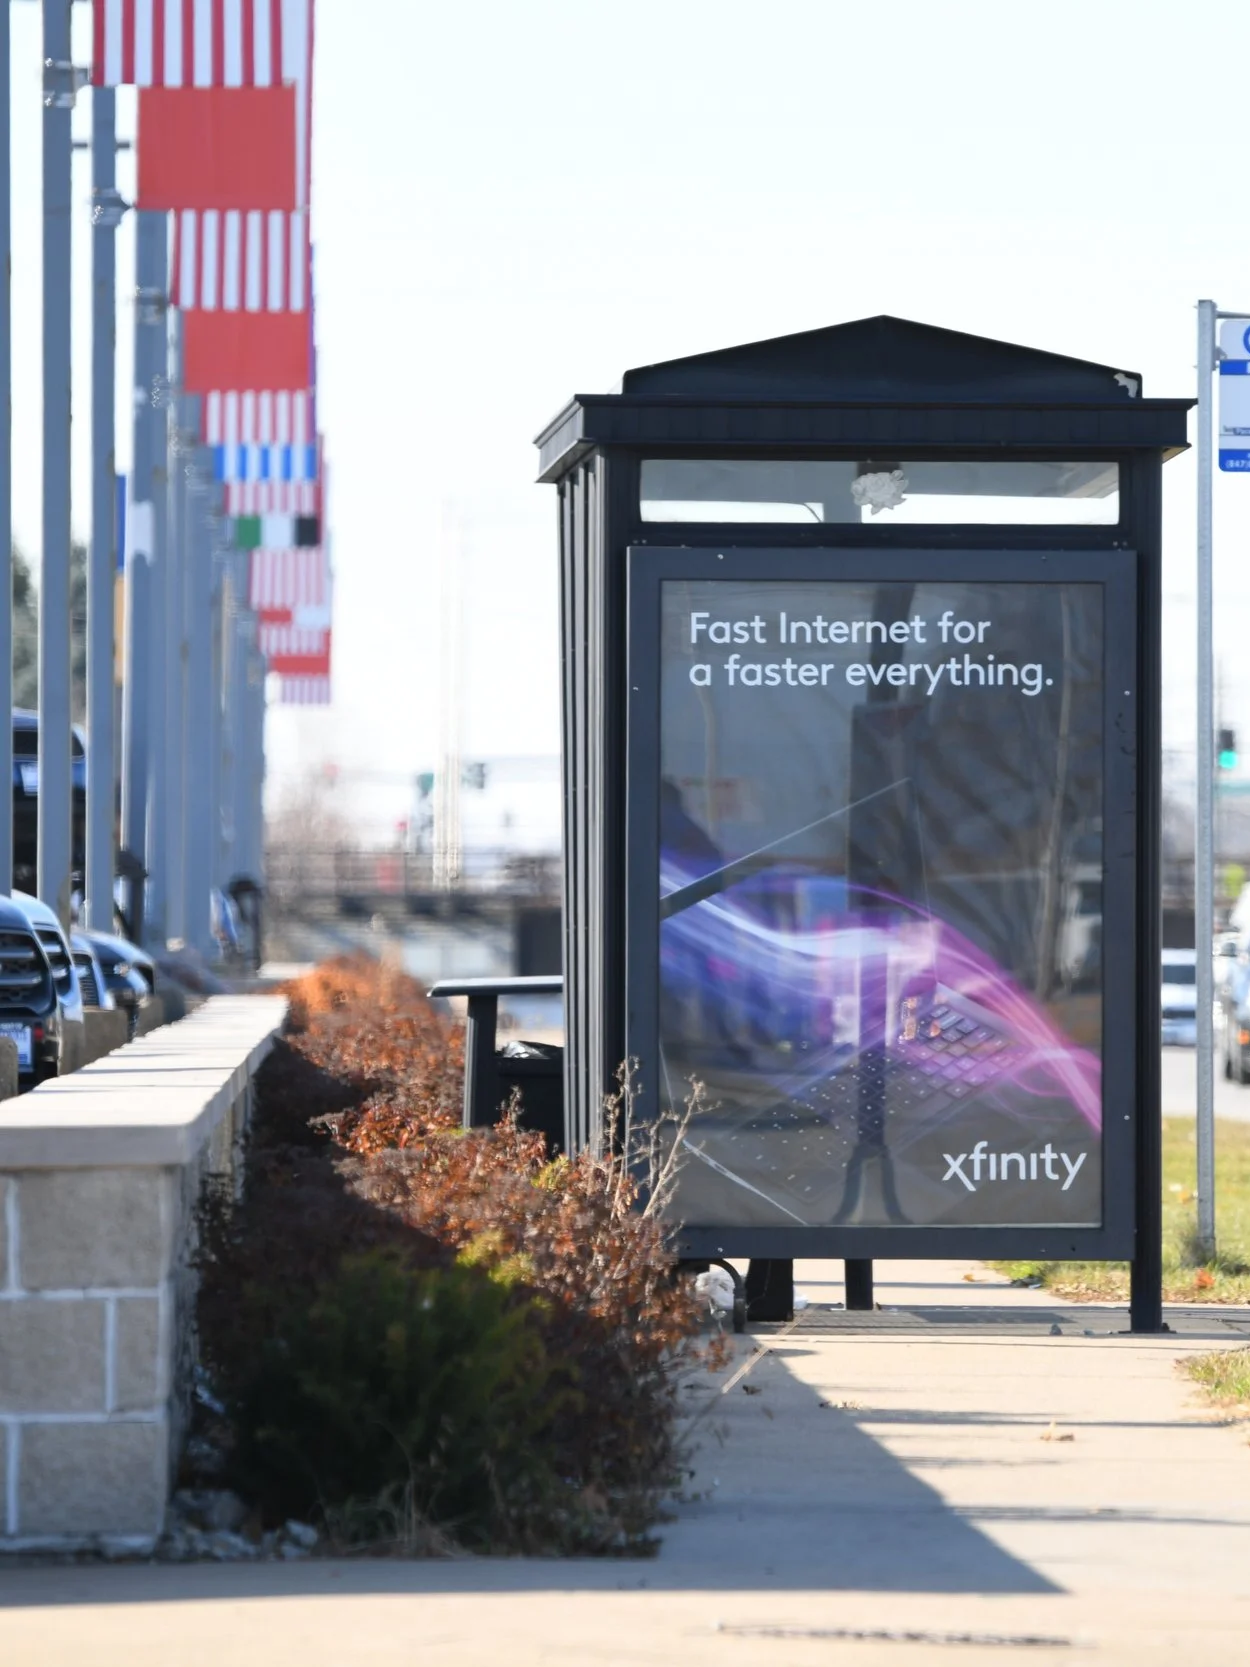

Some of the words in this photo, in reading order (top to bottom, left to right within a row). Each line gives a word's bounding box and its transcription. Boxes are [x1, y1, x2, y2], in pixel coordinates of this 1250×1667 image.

[690, 611, 767, 644] Fast
[779, 611, 927, 644] Internet
[937, 610, 991, 644] for
[688, 663, 712, 687] a
[723, 653, 835, 687] faster
[845, 653, 1054, 696] everything.
[941, 1140, 1088, 1192] xfinity
